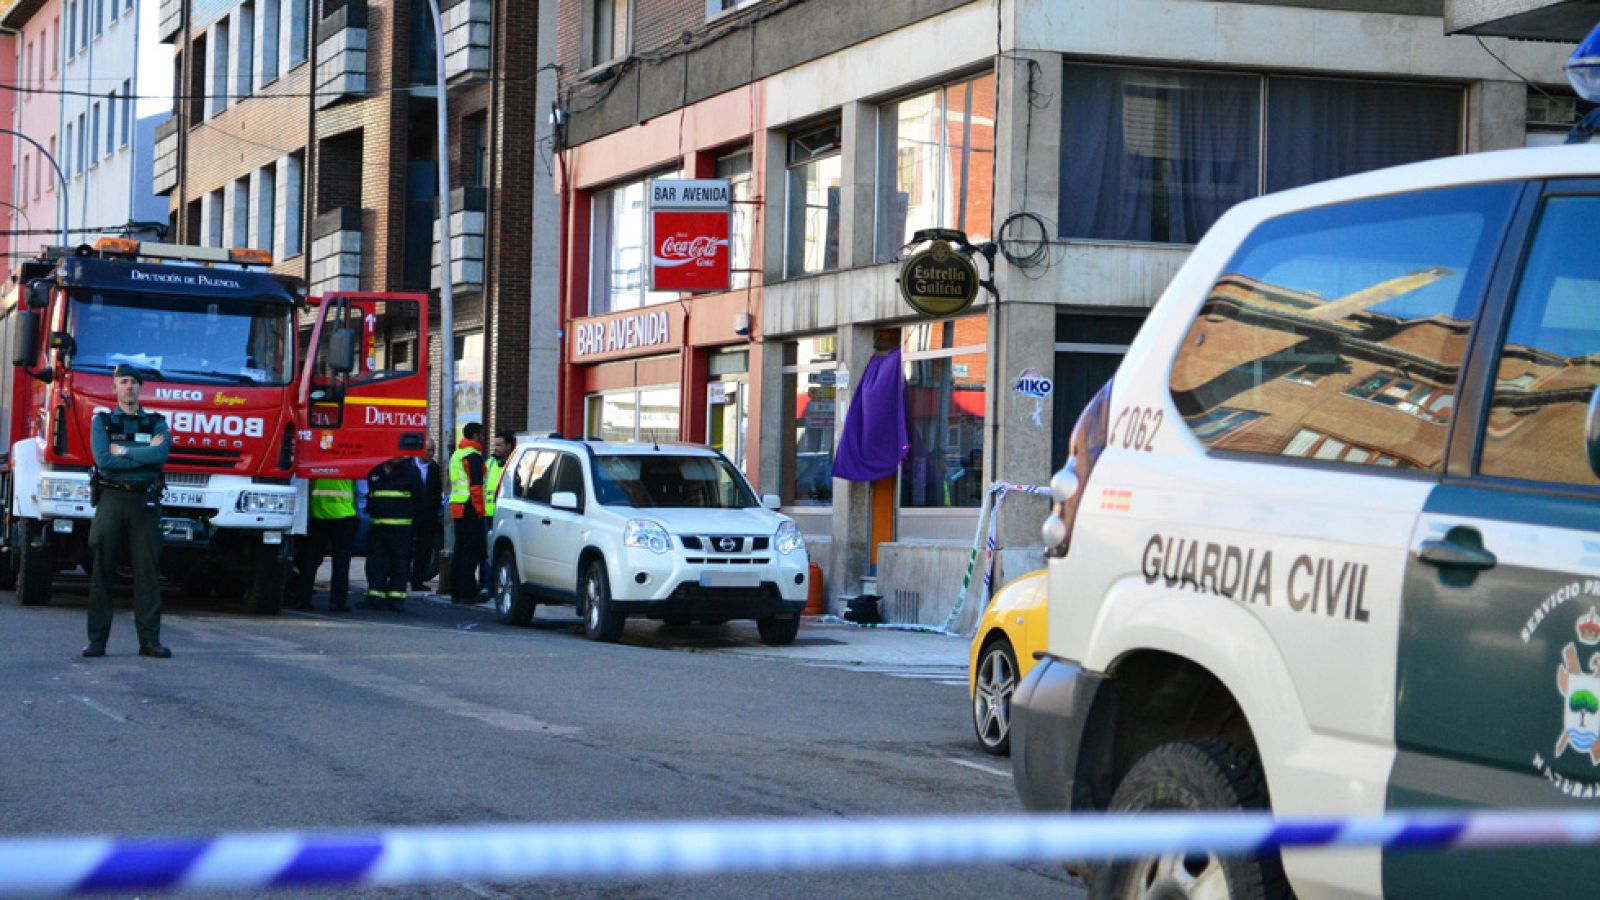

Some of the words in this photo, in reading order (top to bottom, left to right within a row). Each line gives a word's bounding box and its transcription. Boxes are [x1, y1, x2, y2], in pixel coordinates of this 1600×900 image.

[654, 187, 677, 201] BAR
[682, 187, 728, 201] AVENIDA
[914, 265, 966, 281] Estrella
[915, 279, 962, 296] Galicia
[577, 322, 606, 356] BAR
[608, 311, 670, 350] AVENIDA
[155, 387, 204, 401] IVECO
[1122, 406, 1165, 452] 062
[1141, 533, 1273, 607] GUARDIA
[1287, 554, 1370, 624] CIVIL
[1520, 581, 1580, 645] SERVICIO
